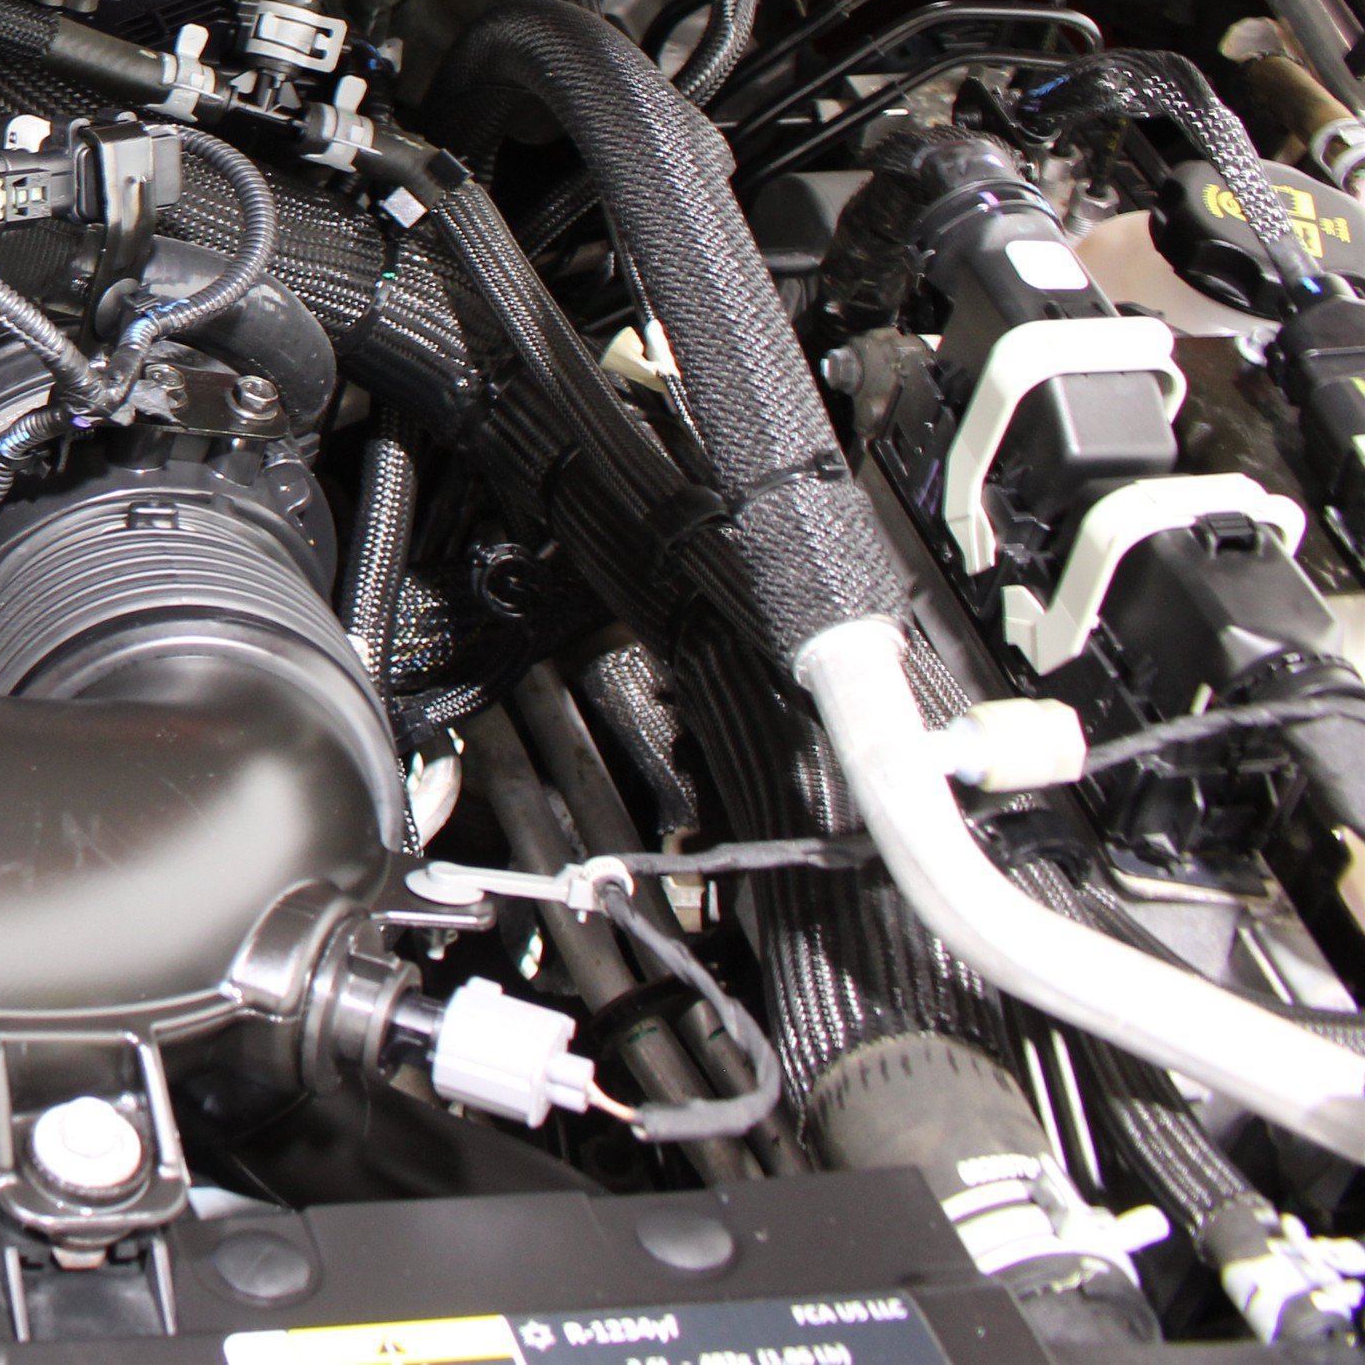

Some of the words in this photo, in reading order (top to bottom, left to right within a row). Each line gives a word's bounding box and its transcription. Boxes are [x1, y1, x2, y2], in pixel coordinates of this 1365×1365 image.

[790, 1303, 838, 1326] FCA
[833, 1300, 869, 1323] US
[866, 1297, 908, 1322] LLC
[562, 1313, 679, 1346] R-1234yf
